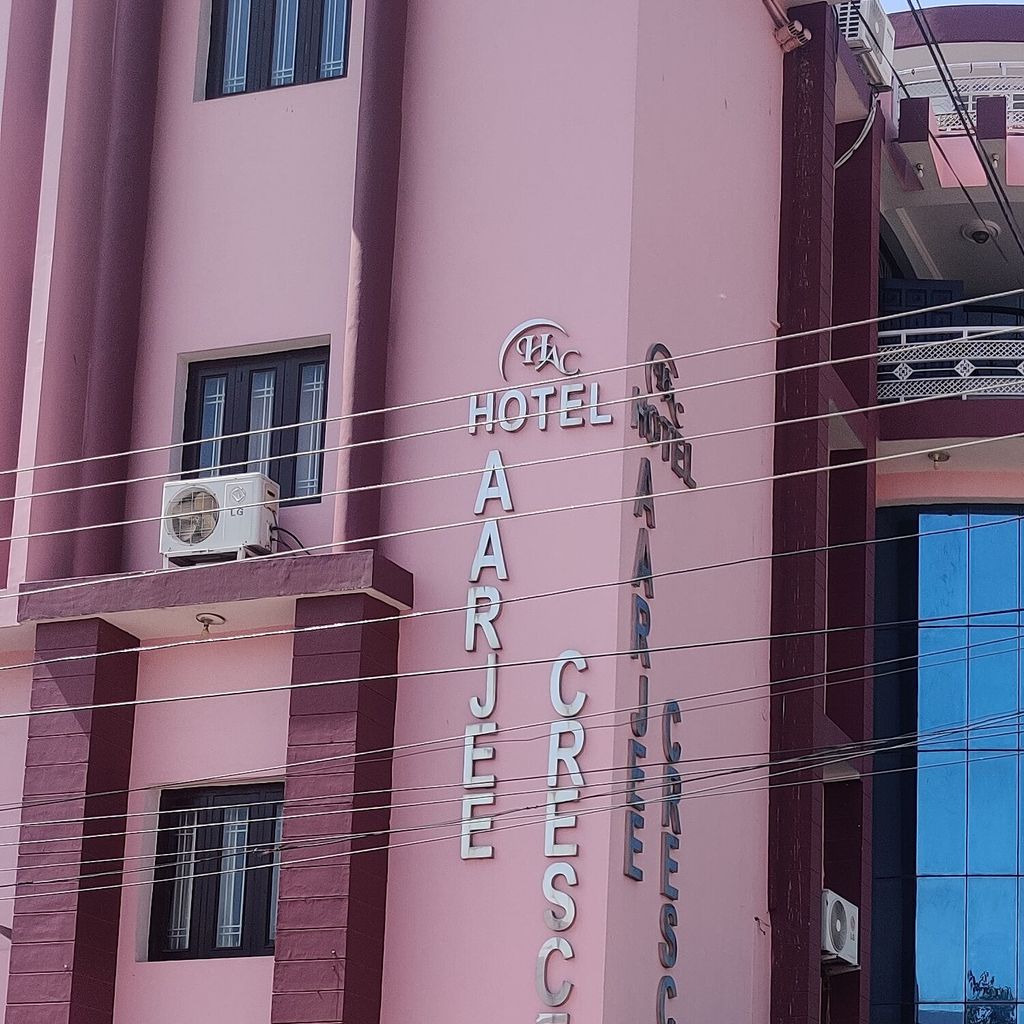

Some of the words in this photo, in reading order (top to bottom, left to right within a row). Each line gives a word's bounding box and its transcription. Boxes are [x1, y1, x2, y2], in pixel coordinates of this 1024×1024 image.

[230, 507, 244, 517] LG
[467, 382, 613, 435] HOTEL
[460, 449, 514, 860] AARJEE
[623, 456, 656, 882] AARJEE
